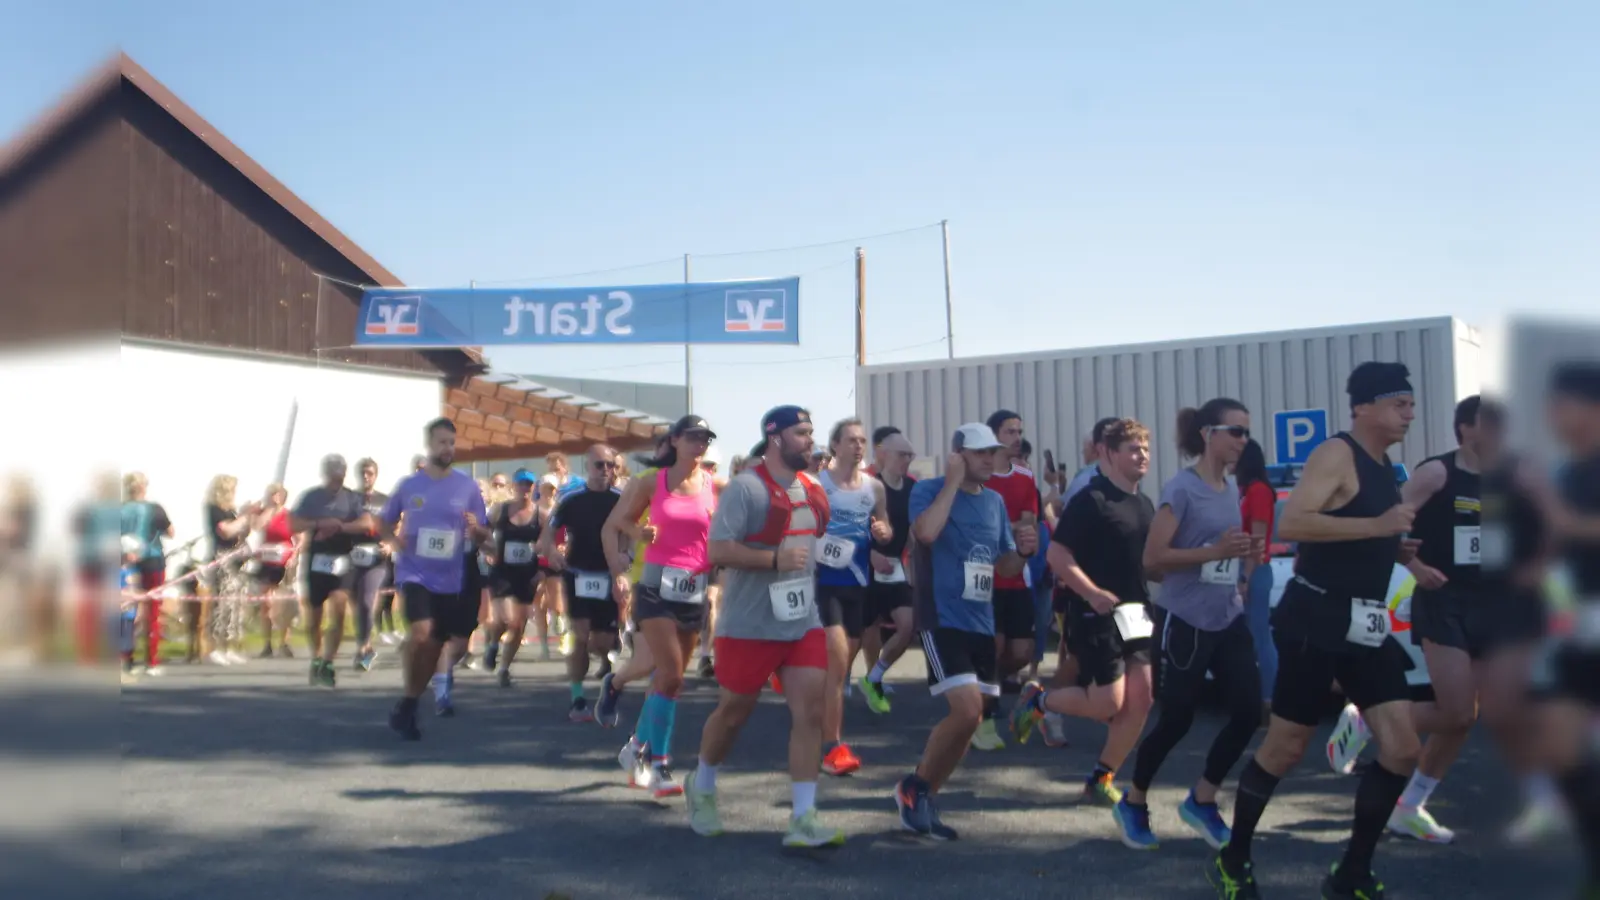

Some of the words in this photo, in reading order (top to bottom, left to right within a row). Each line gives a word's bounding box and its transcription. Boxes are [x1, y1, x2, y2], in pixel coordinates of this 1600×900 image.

[1287, 417, 1315, 458] P
[428, 536, 445, 551] 95
[823, 542, 842, 559] 66
[973, 573, 991, 591] 100
[786, 589, 805, 609] 91
[1367, 612, 1385, 634] 30
